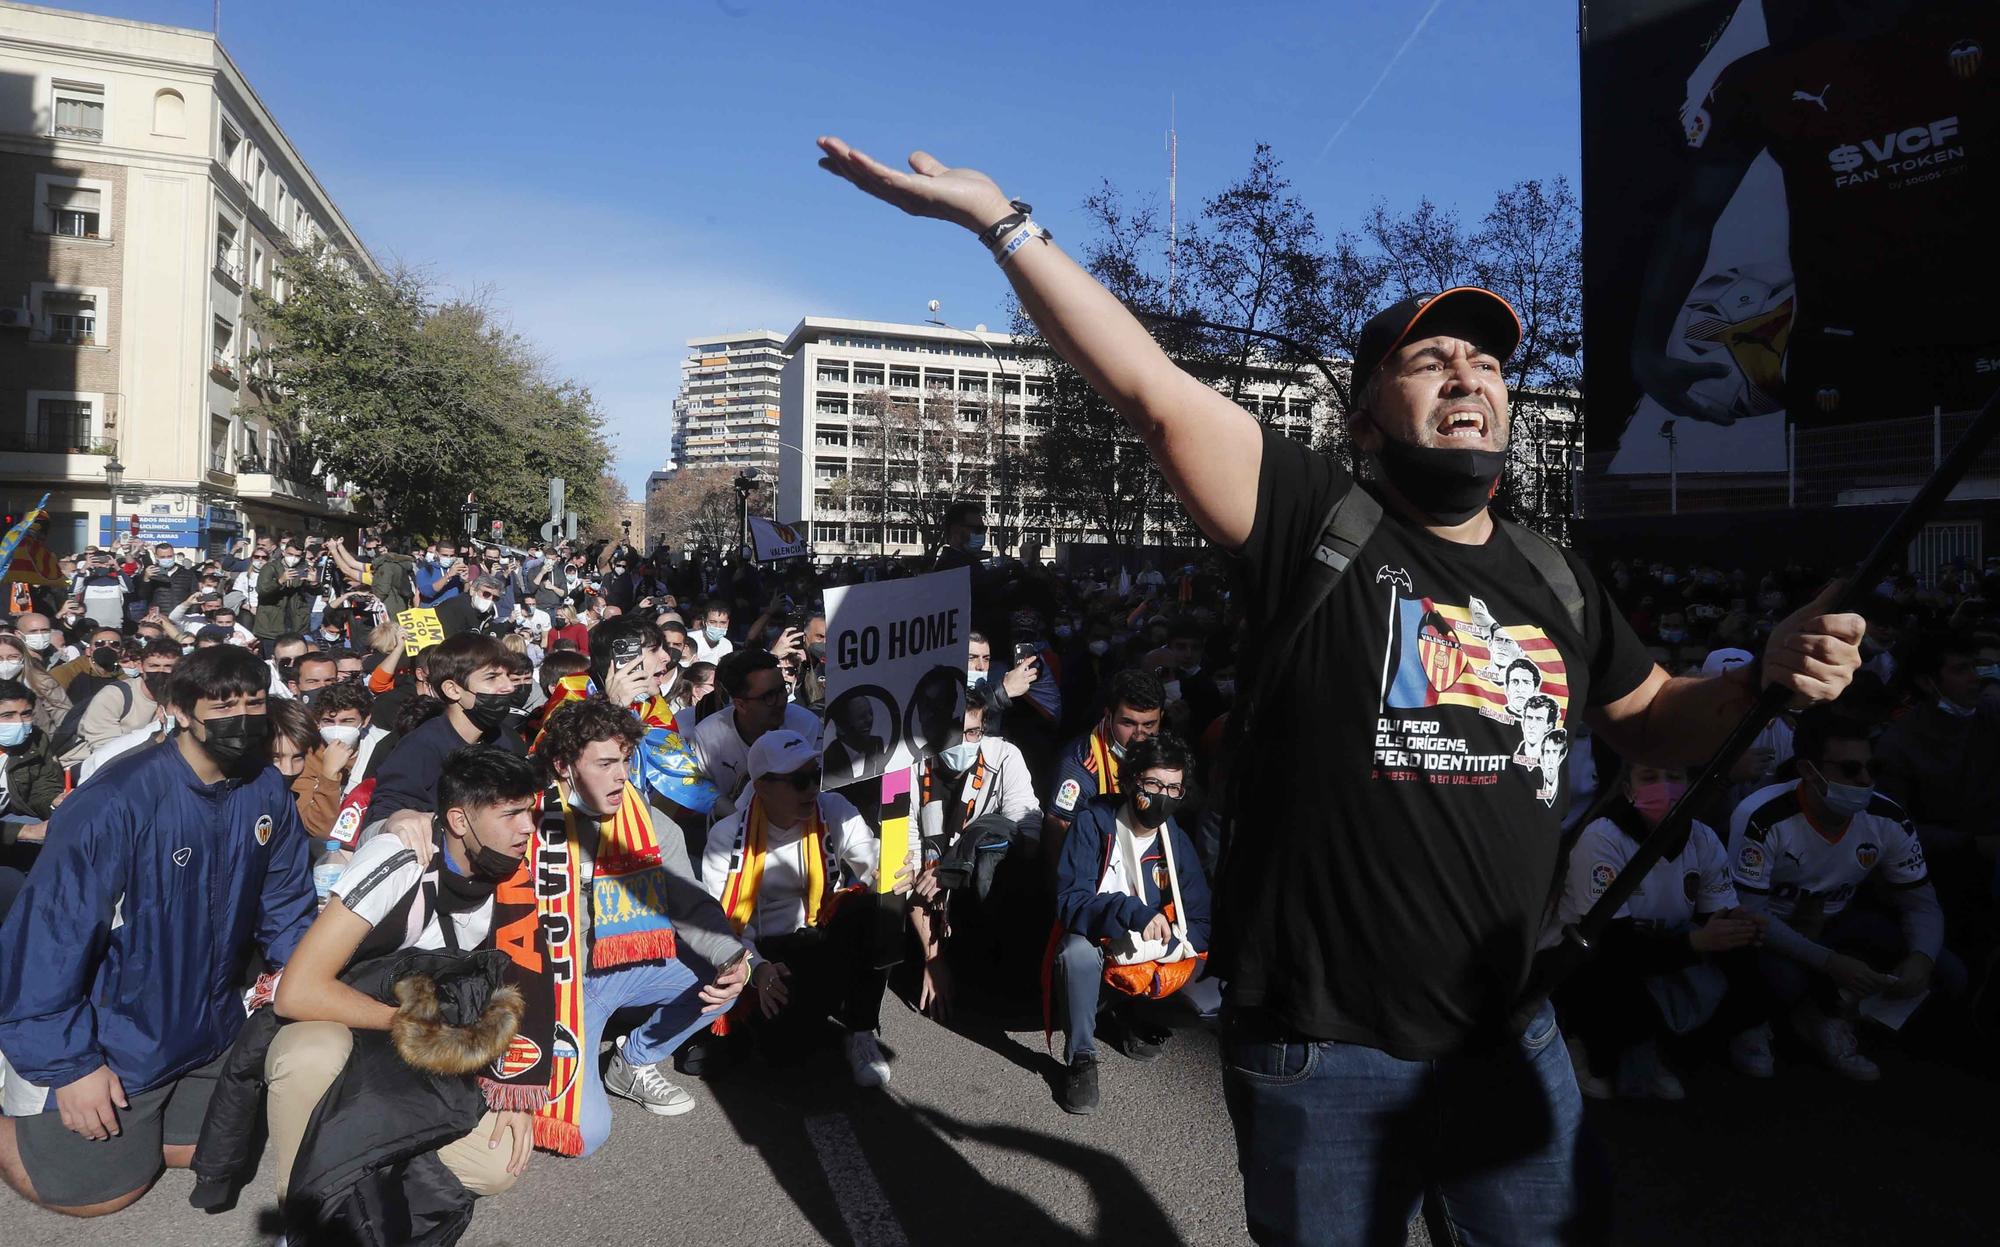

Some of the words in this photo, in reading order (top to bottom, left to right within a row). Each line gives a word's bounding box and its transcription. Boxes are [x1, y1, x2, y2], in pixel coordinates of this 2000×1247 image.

[1828, 115, 1959, 173] $VCF
[1835, 168, 1879, 188] FAN
[1887, 146, 1965, 174] TOKEN
[1007, 230, 1030, 250] BOCA
[400, 613, 420, 652] HOME
[416, 621, 427, 636] GO
[424, 616, 443, 640] LIM
[838, 626, 880, 670] GO
[888, 608, 959, 660] HOME
[1421, 634, 1453, 647] VALENCIA
[1377, 718, 1400, 733] QUI
[1402, 720, 1440, 734] PERD
[1375, 734, 1404, 748] ELS
[1406, 734, 1469, 755] ORÍGENS,
[1373, 750, 1422, 767] PERD
[1424, 753, 1511, 772] IDENTITAT
